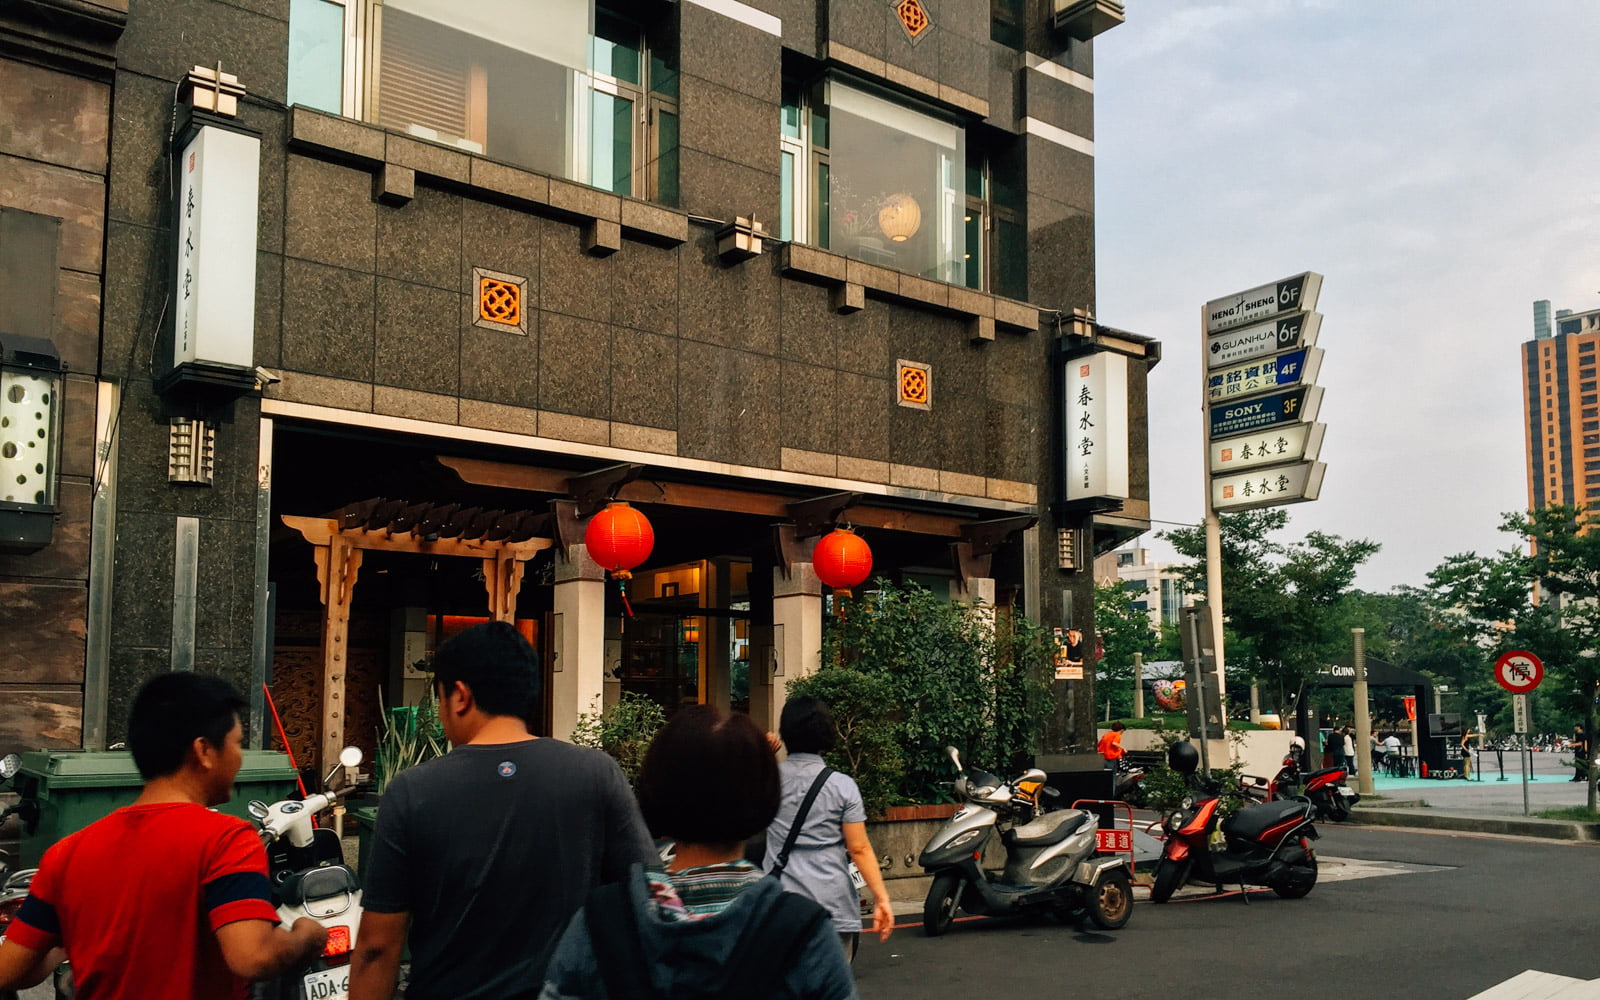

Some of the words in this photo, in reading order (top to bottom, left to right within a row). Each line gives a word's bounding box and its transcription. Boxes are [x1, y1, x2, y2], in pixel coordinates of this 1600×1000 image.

[1279, 284, 1299, 304] 6F
[1211, 307, 1235, 321] HENG
[1245, 296, 1275, 311] SHENG
[1222, 330, 1275, 351] GUANHUA
[1279, 323, 1298, 342] 6F
[1281, 362, 1297, 376] 4F
[1208, 375, 1278, 398] 有限公司
[1225, 403, 1263, 419] SONY
[1283, 398, 1297, 414] 3F
[1077, 384, 1094, 457] 春水堂
[1240, 436, 1288, 460] 春水堂
[1241, 474, 1290, 497] 春水堂
[1331, 664, 1368, 677] GUINNS
[1509, 661, 1531, 682] 停
